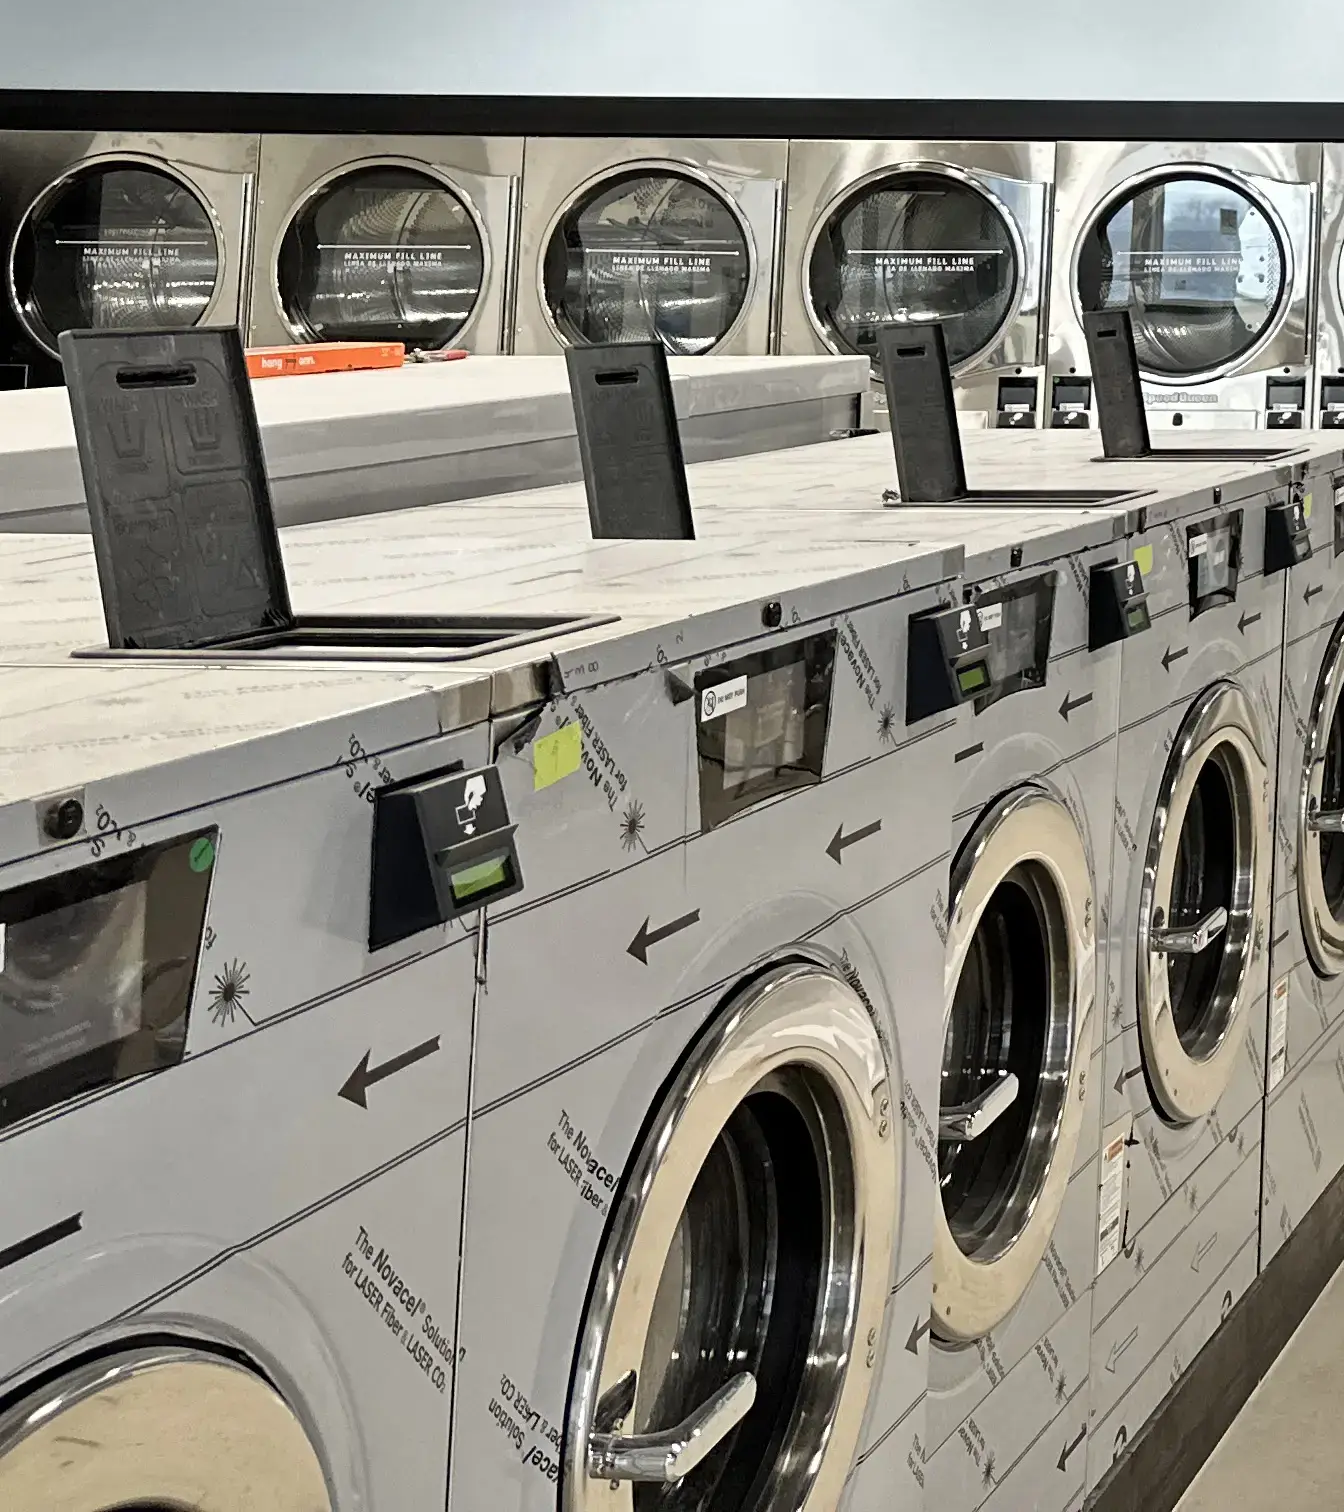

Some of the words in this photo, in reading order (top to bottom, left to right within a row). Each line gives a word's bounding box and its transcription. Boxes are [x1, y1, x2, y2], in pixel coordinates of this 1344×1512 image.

[83, 248, 129, 256] MAXIMUM
[344, 252, 392, 260] MAXIMUM
[395, 252, 416, 260] FILL
[420, 252, 442, 260] LINE
[663, 257, 684, 265] FILL
[688, 257, 711, 265] LINE
[875, 257, 923, 265] MAXIMUM
[927, 257, 948, 265] FILL
[952, 257, 975, 265] LINE
[1144, 258, 1192, 266] MAXIMUM
[1196, 258, 1216, 266] FILL
[591, 731, 616, 776] LASER
[603, 780, 619, 813] The
[614, 769, 628, 792] for
[557, 1108, 574, 1140] The
[546, 1131, 561, 1155] for
[557, 1146, 583, 1186] LASER
[354, 1225, 374, 1261] The
[341, 1252, 358, 1278] for
[354, 1267, 384, 1313] LASER
[380, 1301, 404, 1337] Fiber
[406, 1333, 434, 1377] LASER
[488, 1397, 525, 1450] Solution
